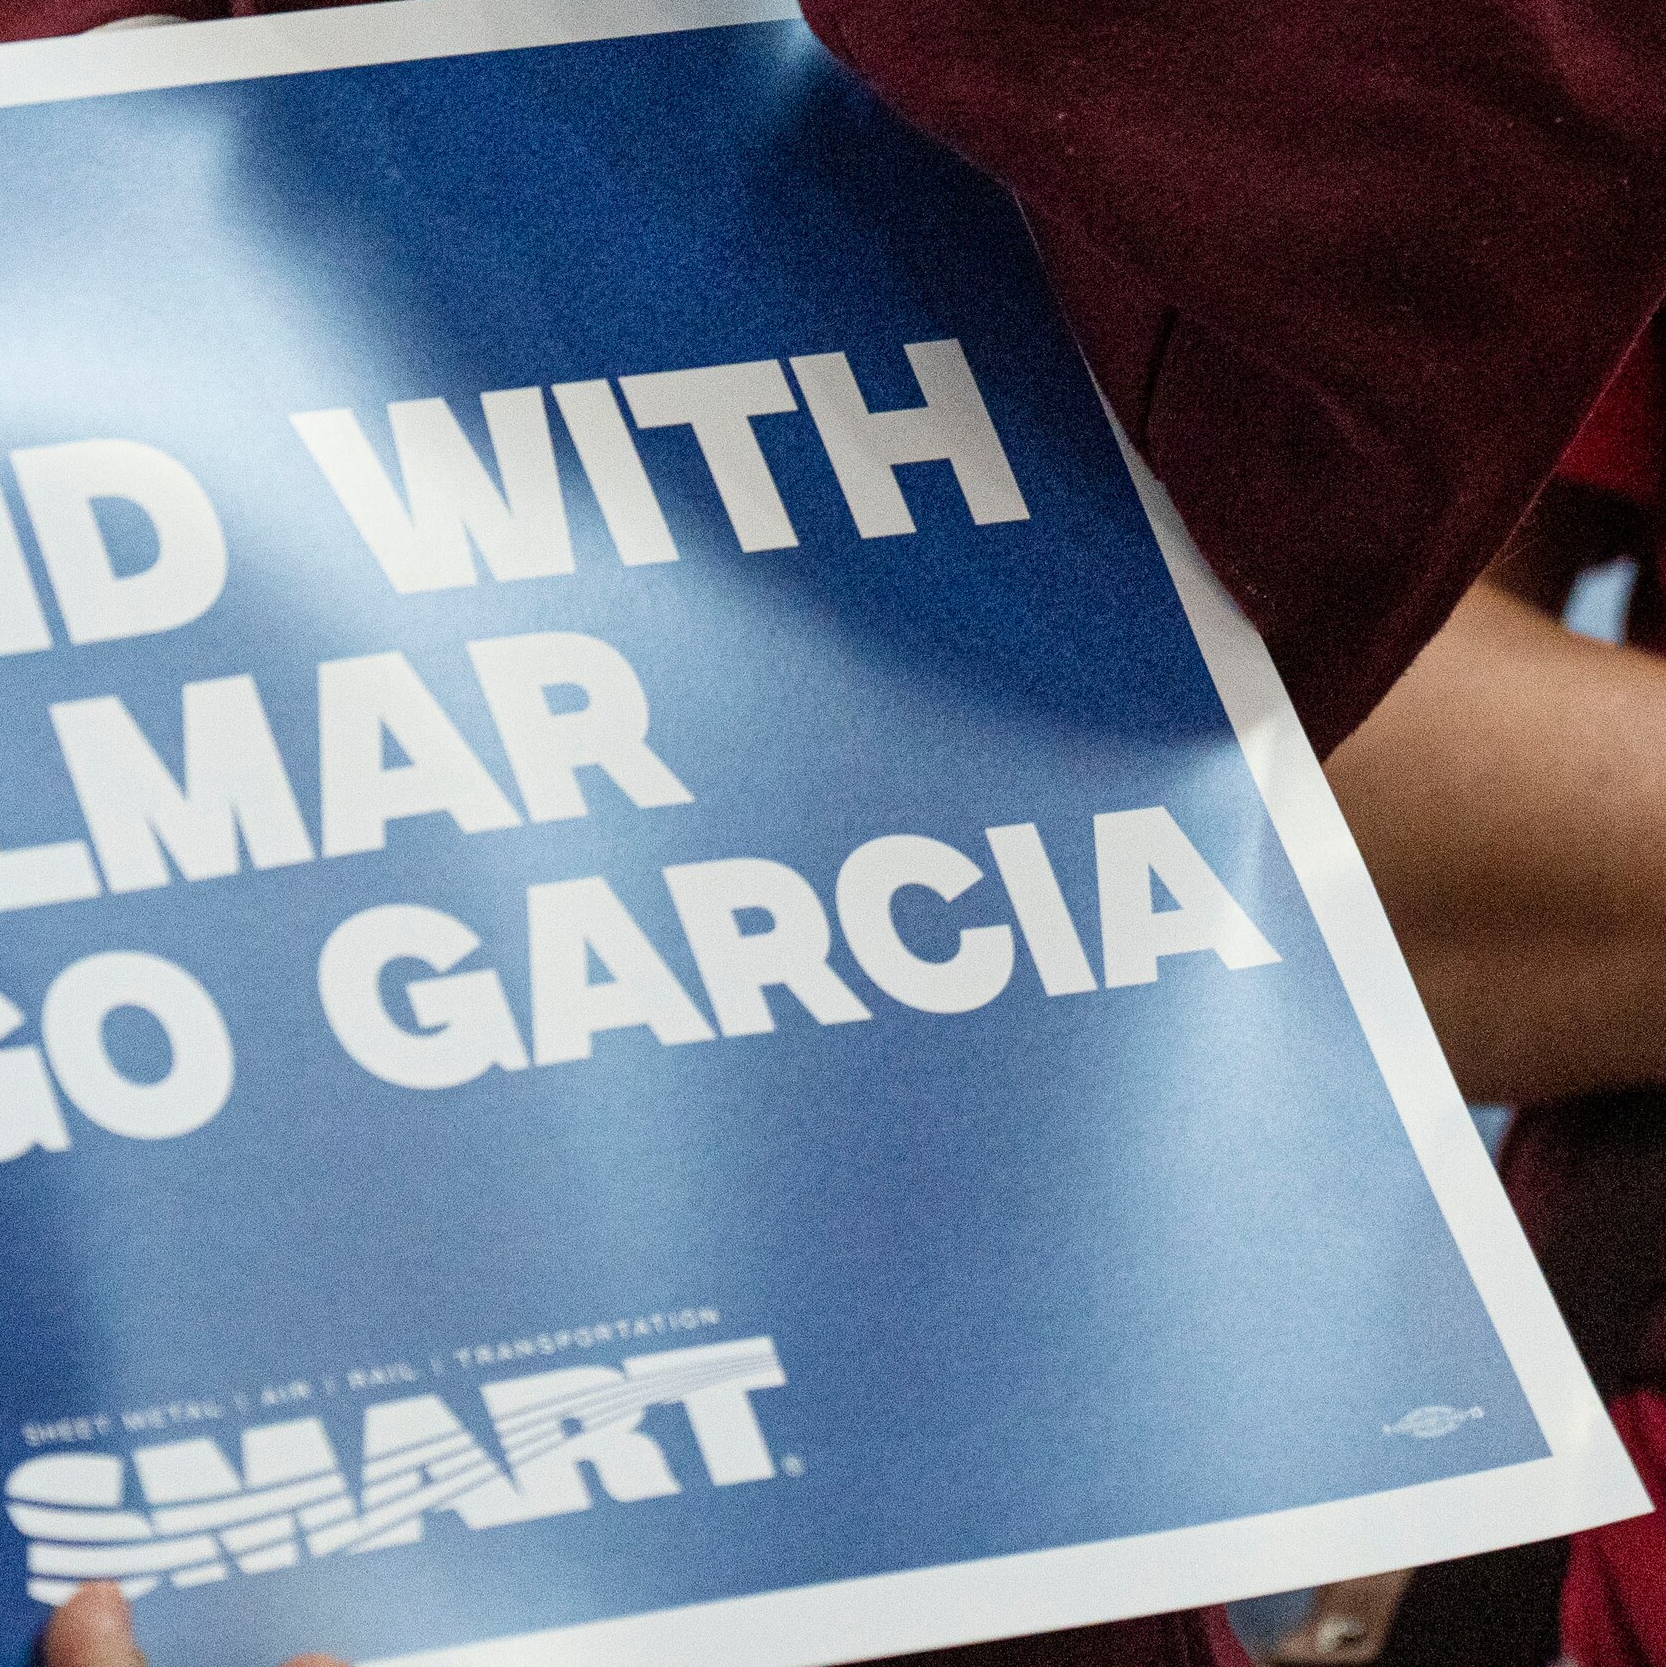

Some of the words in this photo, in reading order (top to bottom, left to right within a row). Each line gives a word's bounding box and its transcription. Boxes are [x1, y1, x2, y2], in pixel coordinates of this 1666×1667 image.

[287, 337, 1031, 596] WITH
[317, 804, 1284, 1090] GARCIA
[453, 1305, 721, 1370] TRANSPORTATION
